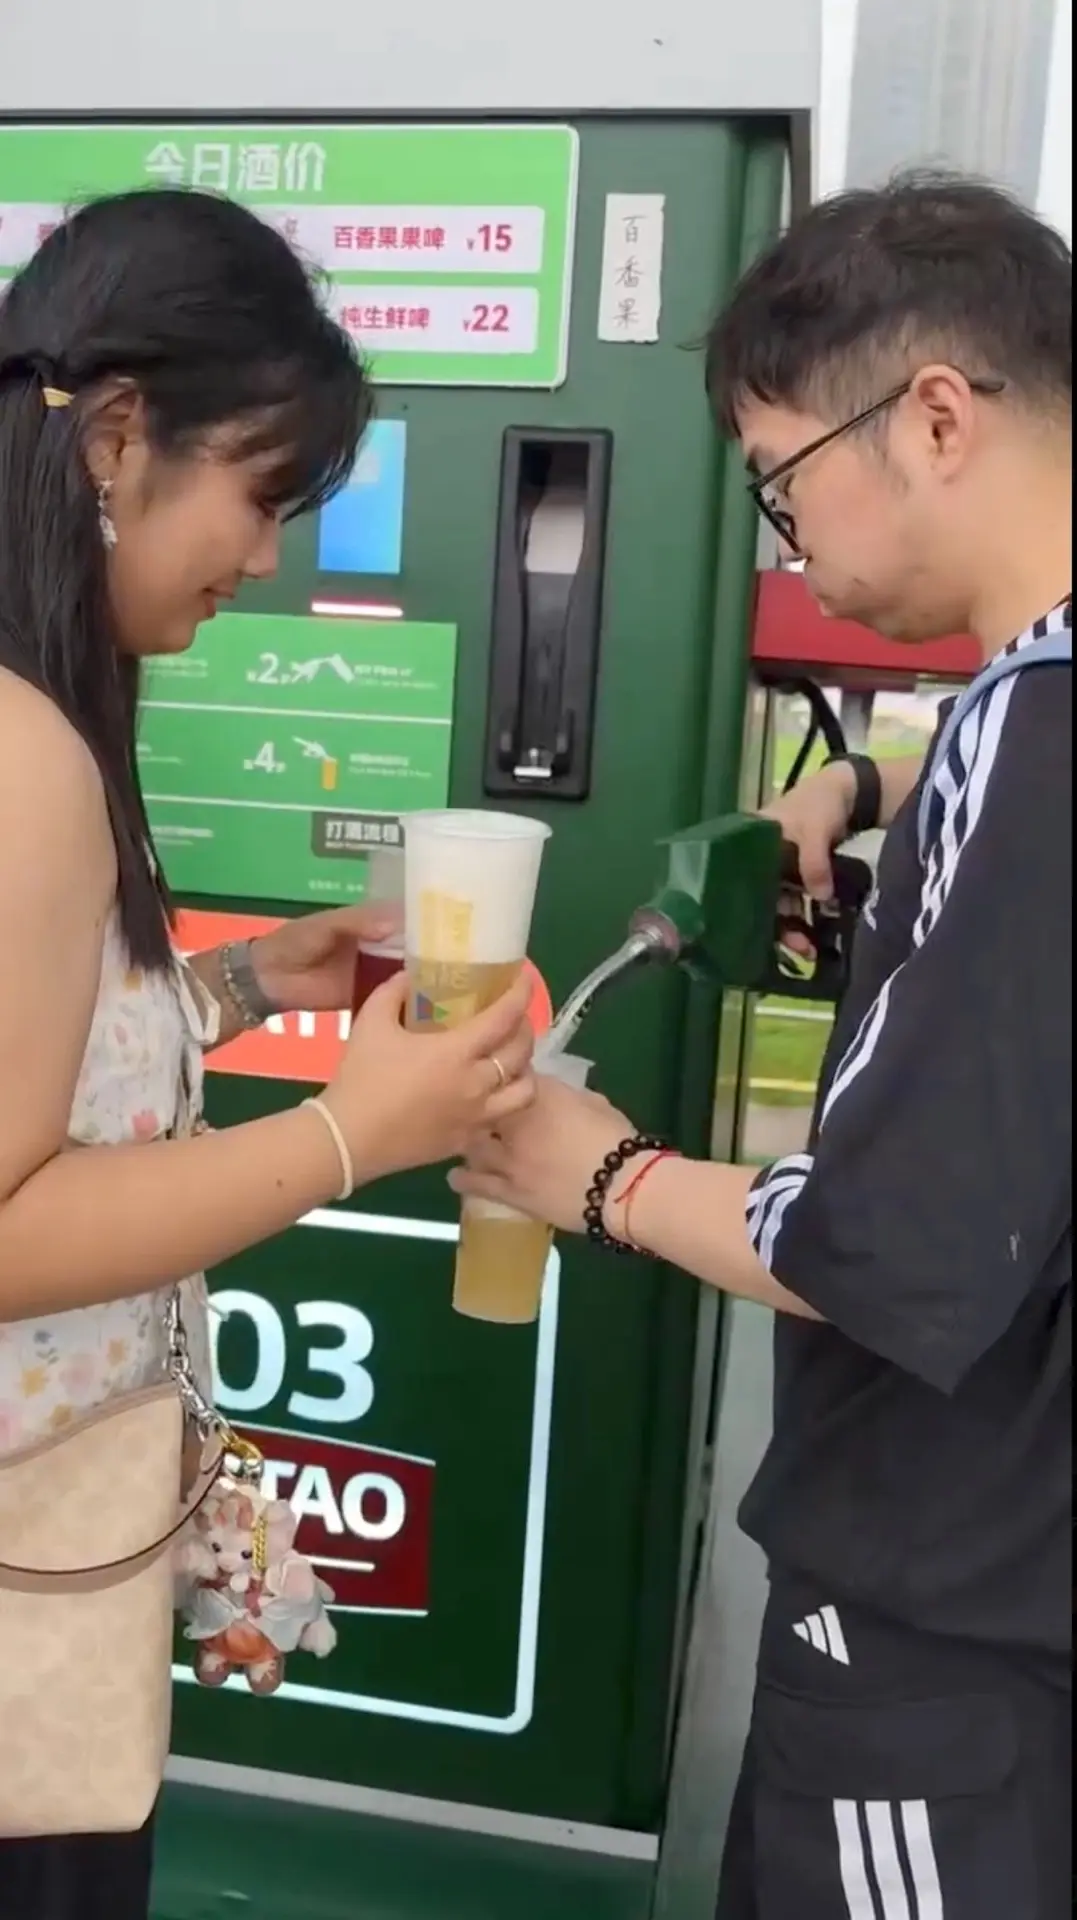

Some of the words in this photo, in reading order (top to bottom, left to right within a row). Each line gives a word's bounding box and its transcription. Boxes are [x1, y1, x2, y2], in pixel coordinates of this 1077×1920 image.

[145, 141, 327, 192] 今日酒价
[334, 226, 445, 250] 百香果果啤
[612, 214, 649, 330] 百香果
[207, 1289, 375, 1423] 03
